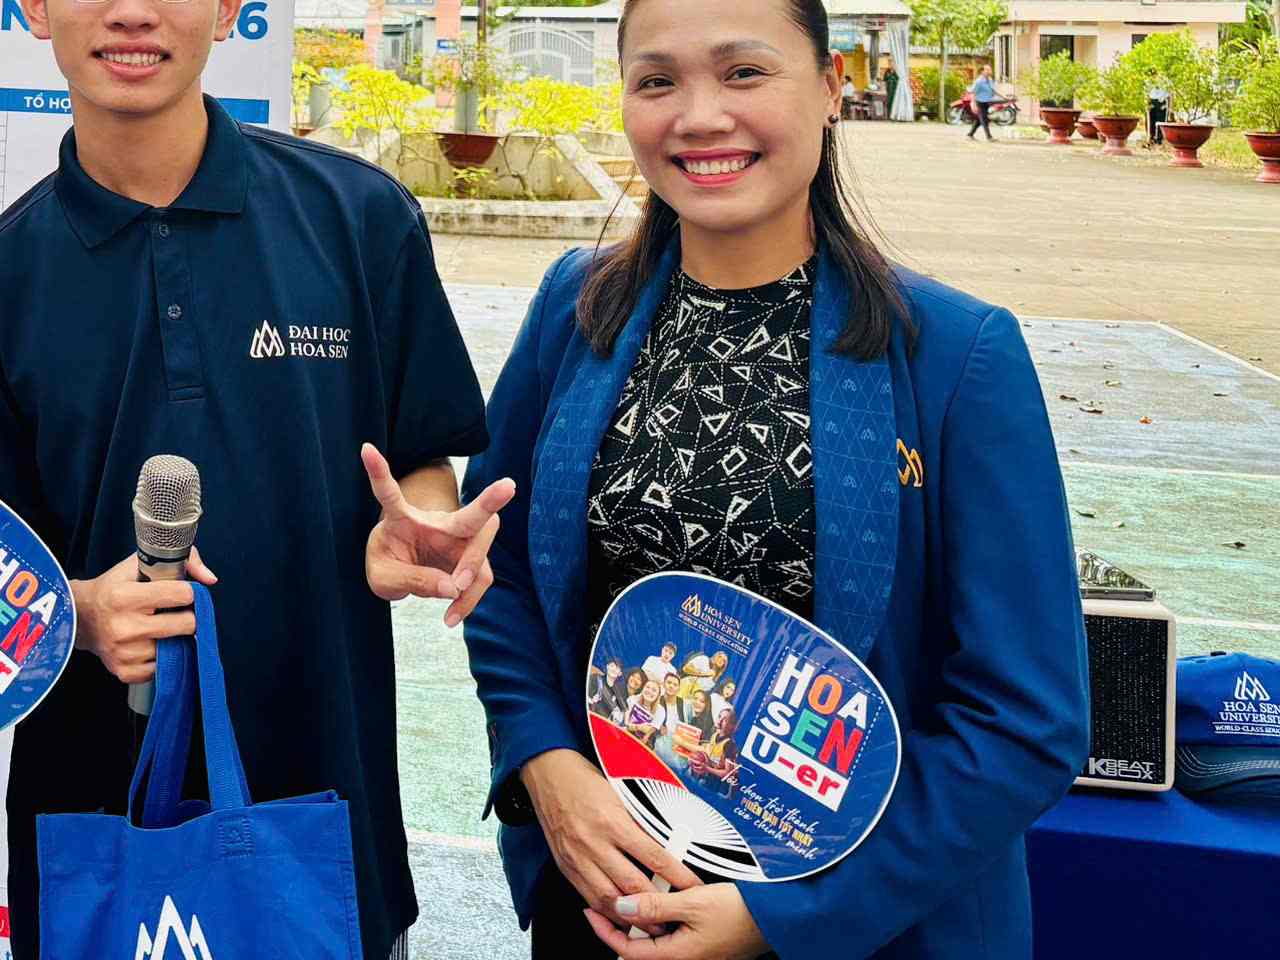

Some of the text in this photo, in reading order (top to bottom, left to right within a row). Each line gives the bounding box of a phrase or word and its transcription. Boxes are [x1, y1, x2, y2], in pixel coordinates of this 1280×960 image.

[288, 325, 318, 341] ĐẠI
[289, 342, 349, 359] HOA SEN
[700, 611, 754, 646] UNIVERSITY
[703, 603, 743, 631] HOA SEN
[772, 652, 870, 730] HOA
[1219, 711, 1280, 724] UNIVERSIT
[1222, 701, 1259, 712] HOA
[761, 699, 864, 776] SEN
[750, 728, 841, 797] U-er
